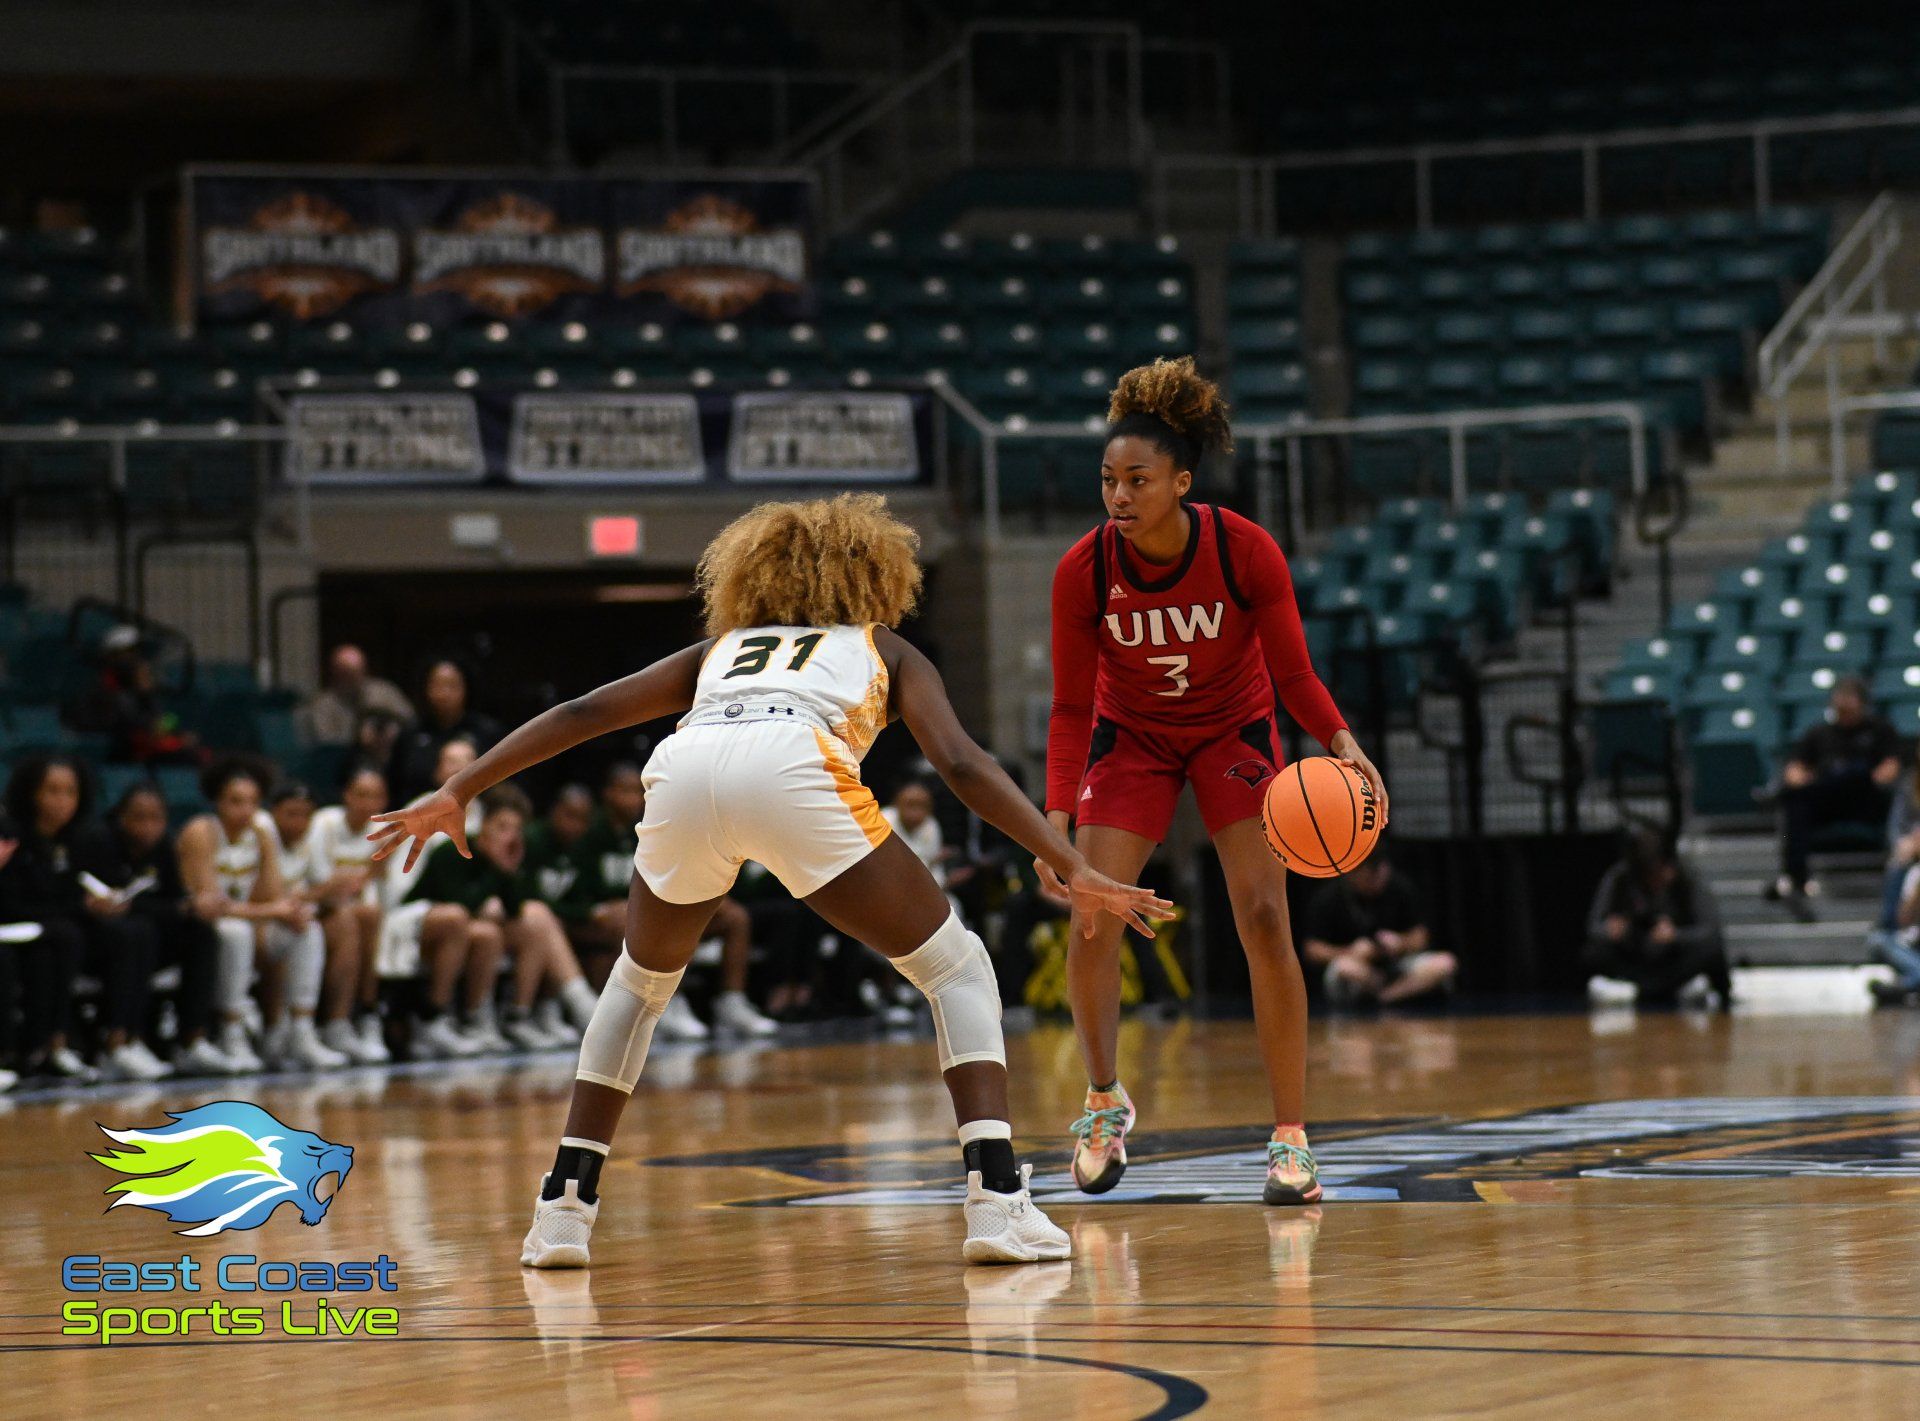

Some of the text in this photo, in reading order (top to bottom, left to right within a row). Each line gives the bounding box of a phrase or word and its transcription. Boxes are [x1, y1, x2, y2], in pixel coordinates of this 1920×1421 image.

[1103, 601, 1224, 647] UIW
[721, 632, 829, 679] 31
[1146, 654, 1190, 697] 3
